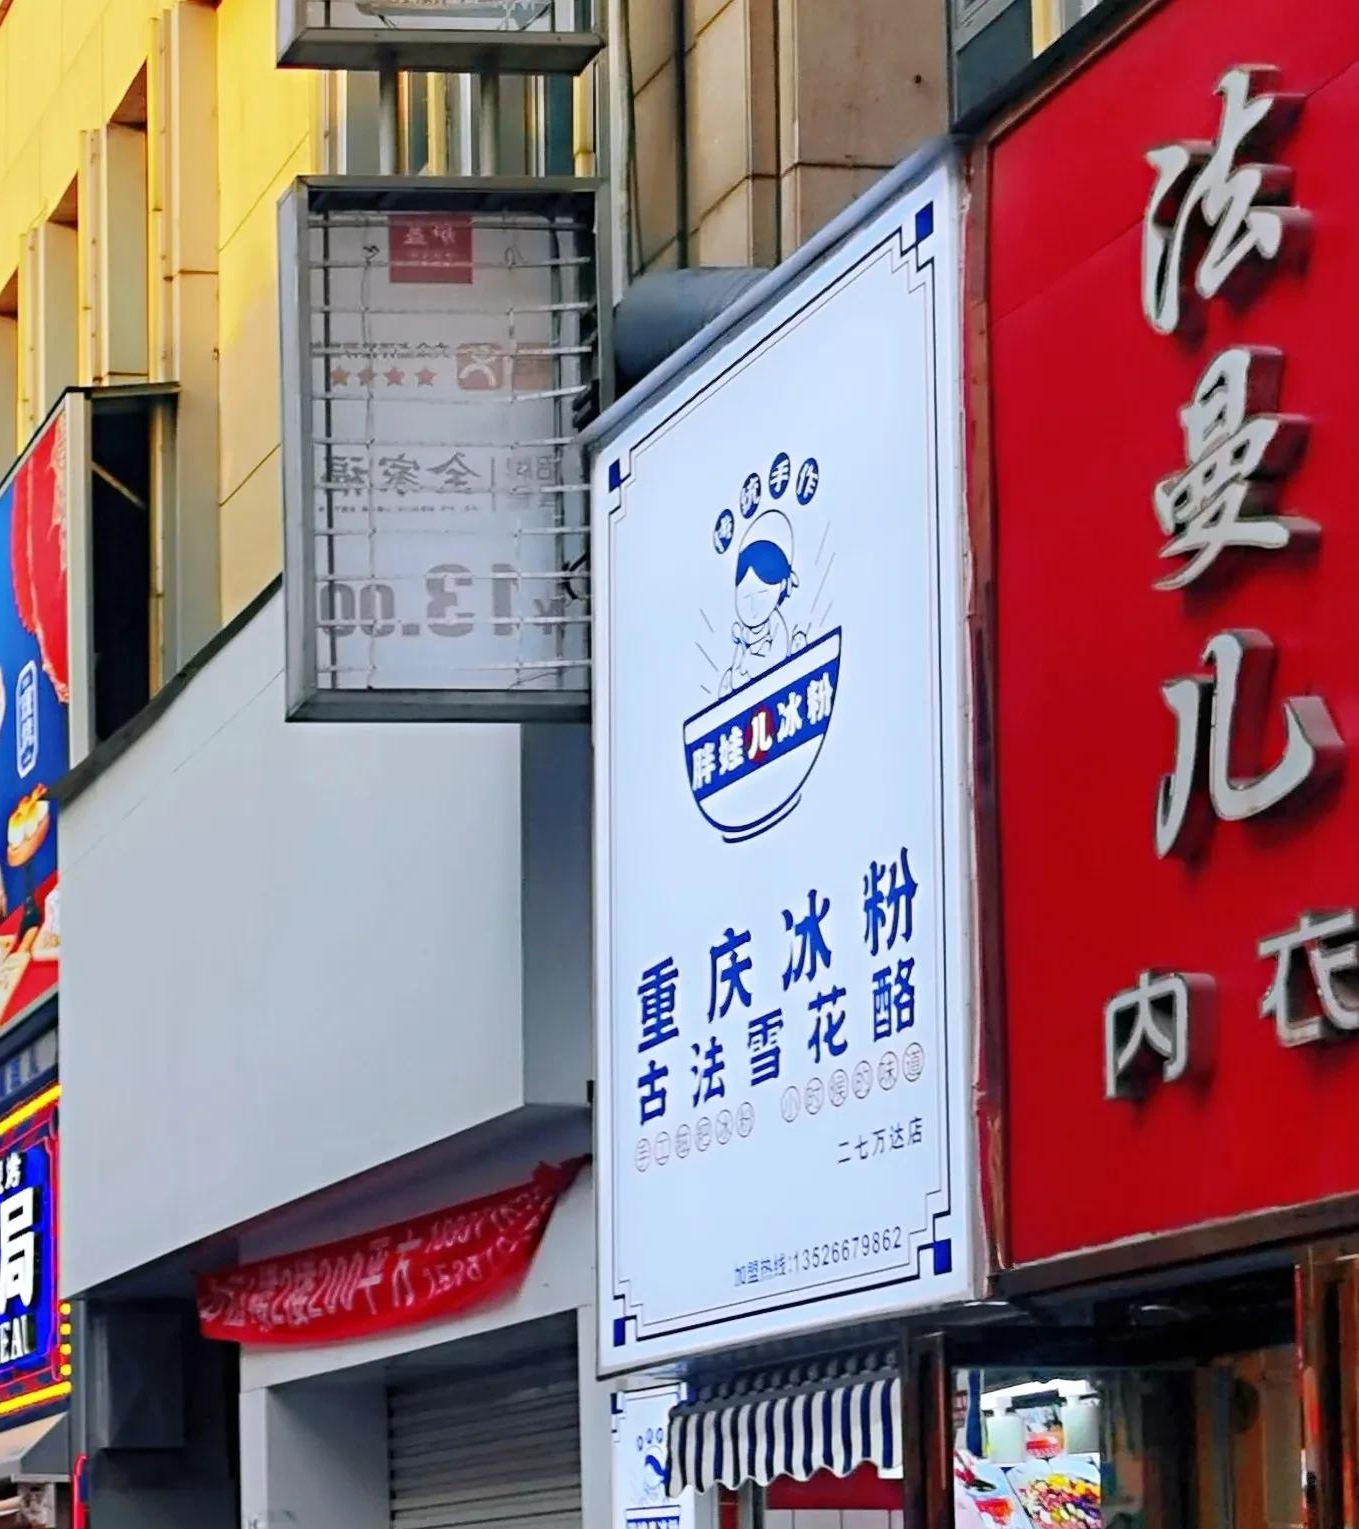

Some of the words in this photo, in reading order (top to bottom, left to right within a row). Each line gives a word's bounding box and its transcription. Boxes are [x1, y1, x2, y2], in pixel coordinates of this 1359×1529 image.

[1140, 66, 1315, 860] 法曼儿
[691, 673, 834, 790] 胖娃儿冰粉
[638, 846, 919, 1055] 重庆冰粉
[638, 957, 917, 1127] 古法雪花酪
[837, 1116, 922, 1164] 二七万达店
